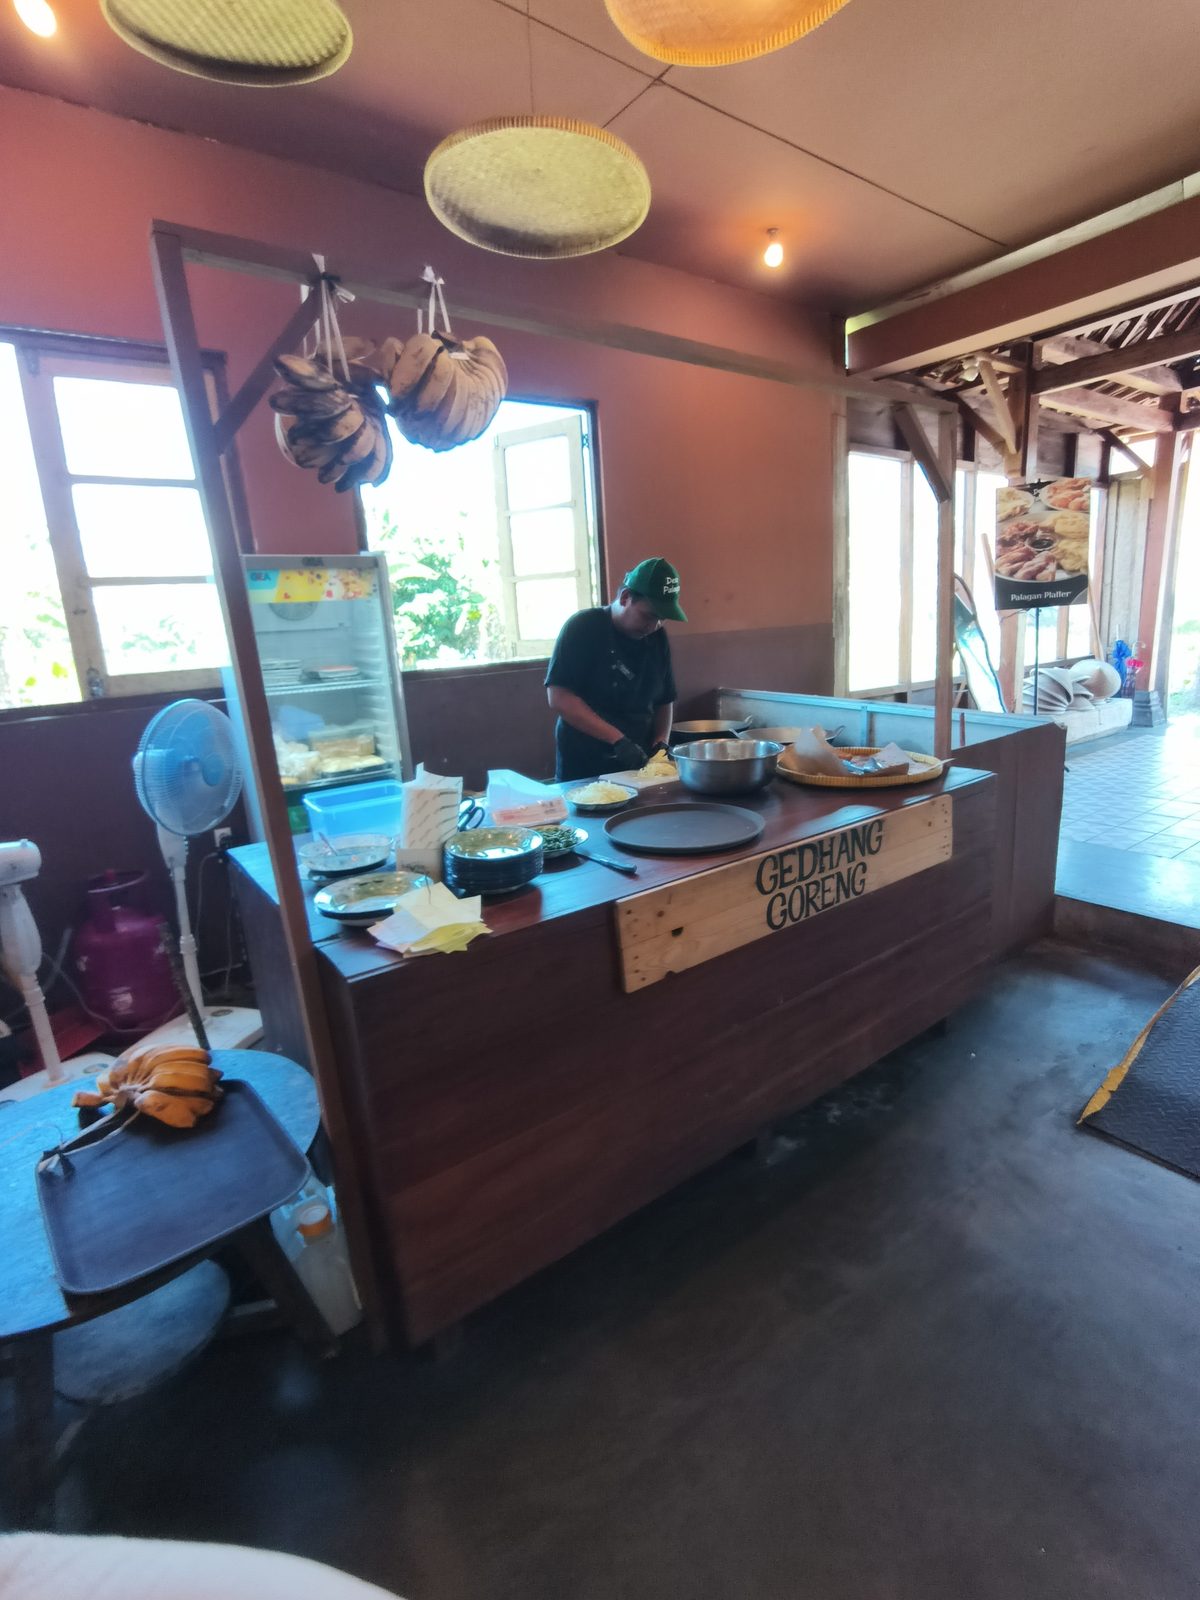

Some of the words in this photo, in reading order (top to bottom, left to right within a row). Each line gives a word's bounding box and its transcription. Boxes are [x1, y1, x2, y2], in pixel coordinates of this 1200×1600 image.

[1010, 593, 1042, 602] Palagan
[755, 818, 884, 896] GEDHANG
[766, 861, 868, 930] GORENG
